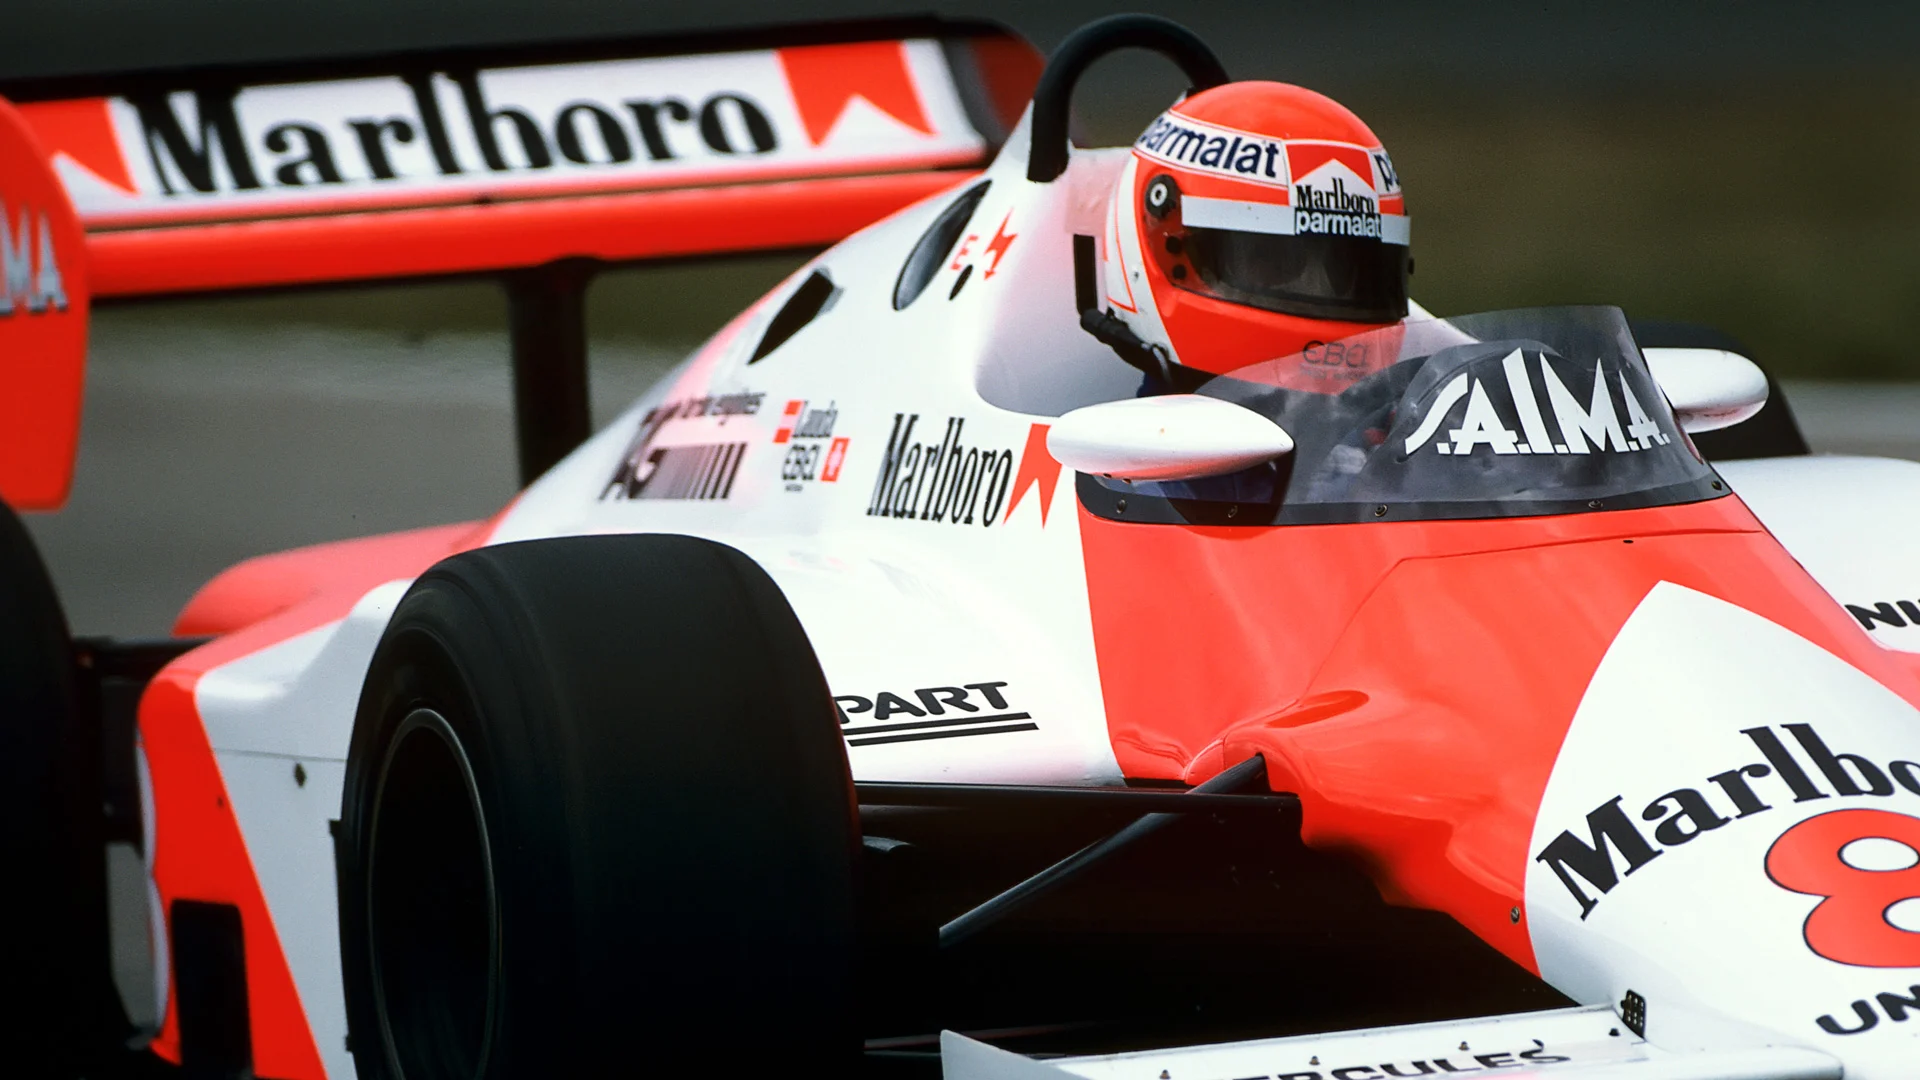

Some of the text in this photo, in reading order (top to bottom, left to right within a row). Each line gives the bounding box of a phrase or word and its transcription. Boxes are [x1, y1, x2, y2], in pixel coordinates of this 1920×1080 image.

[130, 66, 779, 195] Marlboro
[1296, 177, 1375, 213] Marlboro
[1295, 210, 1382, 238] parmalat
[950, 234, 979, 271] E
[866, 413, 1013, 527] Marlboro
[833, 681, 1008, 724] PART
[1764, 808, 1920, 968] 8
